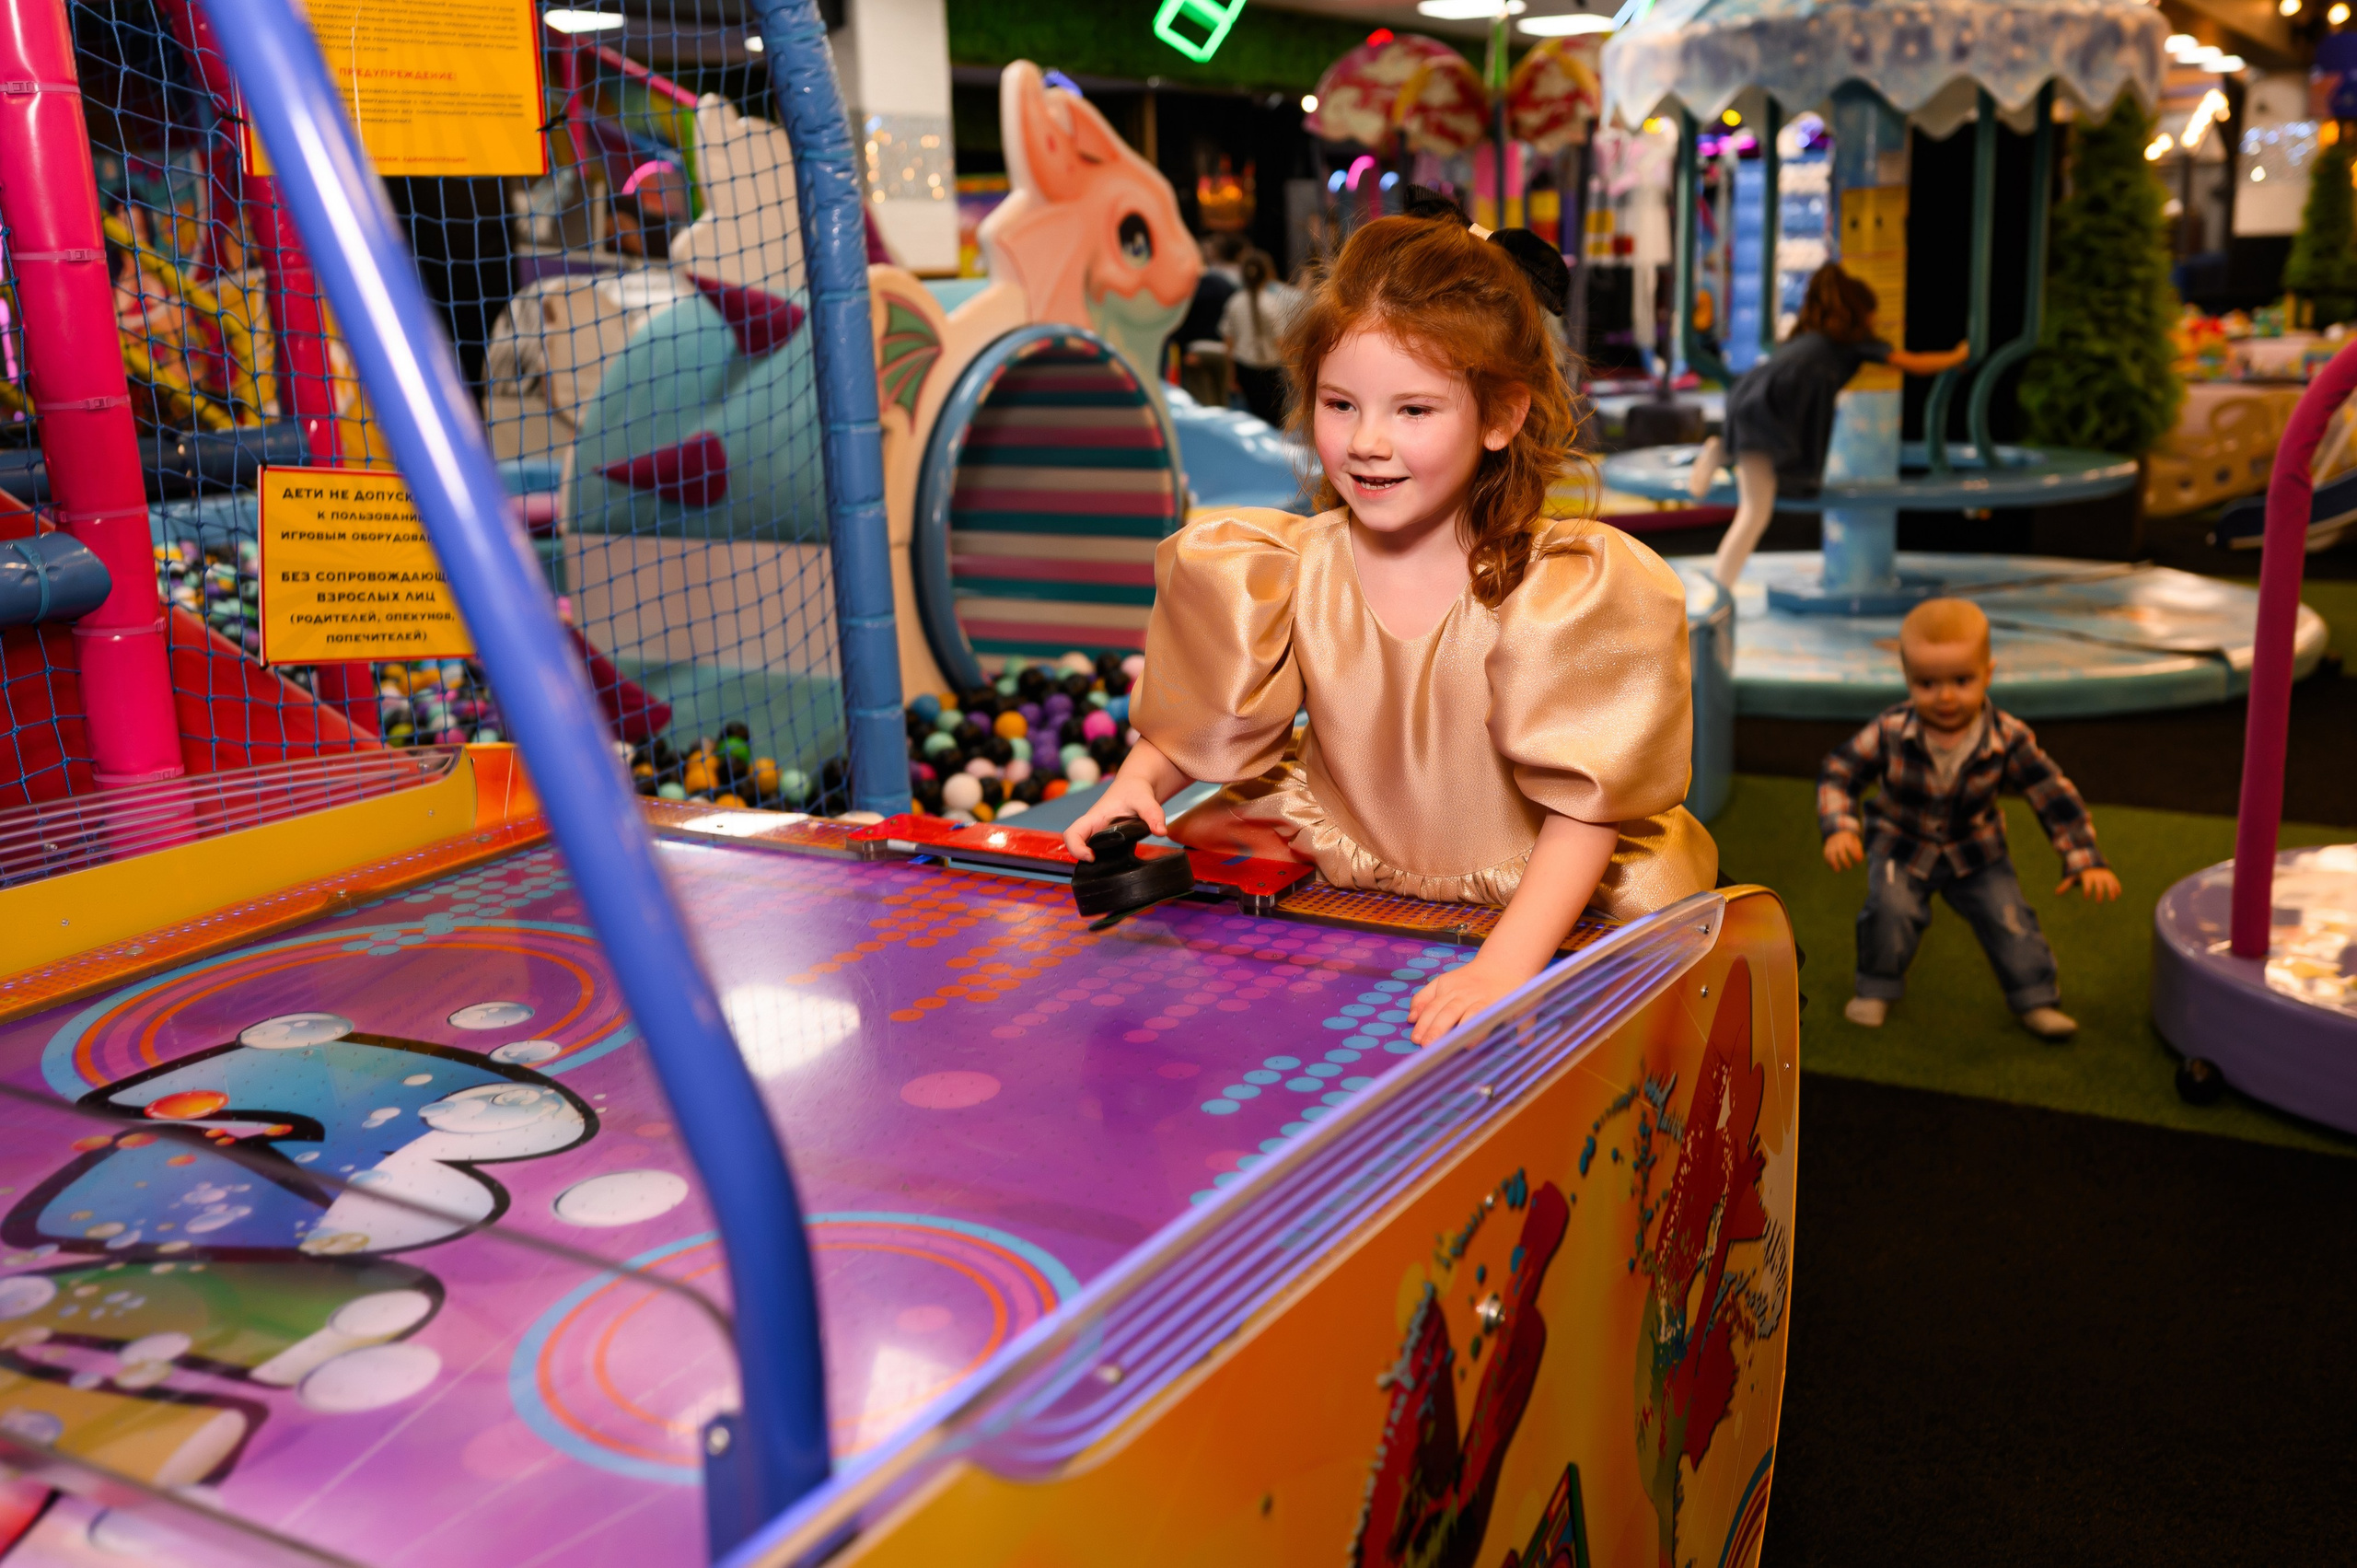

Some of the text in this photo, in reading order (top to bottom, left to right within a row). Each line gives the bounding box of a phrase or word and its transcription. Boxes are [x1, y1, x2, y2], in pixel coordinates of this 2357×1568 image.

[283, 488, 416, 503] ДЕТИ НЕ ДОПУСК
[318, 511, 325, 520] К
[281, 531, 346, 541] ИГРОВЫМ
[282, 572, 448, 585] БЕЗ СОПРОВОЖДАЮЩ
[317, 592, 435, 603] ВЗРОСЛЫХ ЛИЦ
[290, 612, 455, 624] (РОДИТЕЛЕЙ, ОПЕКУНОВ,
[326, 631, 427, 644] ПОПЕЧИТЕЛЕЙ)
